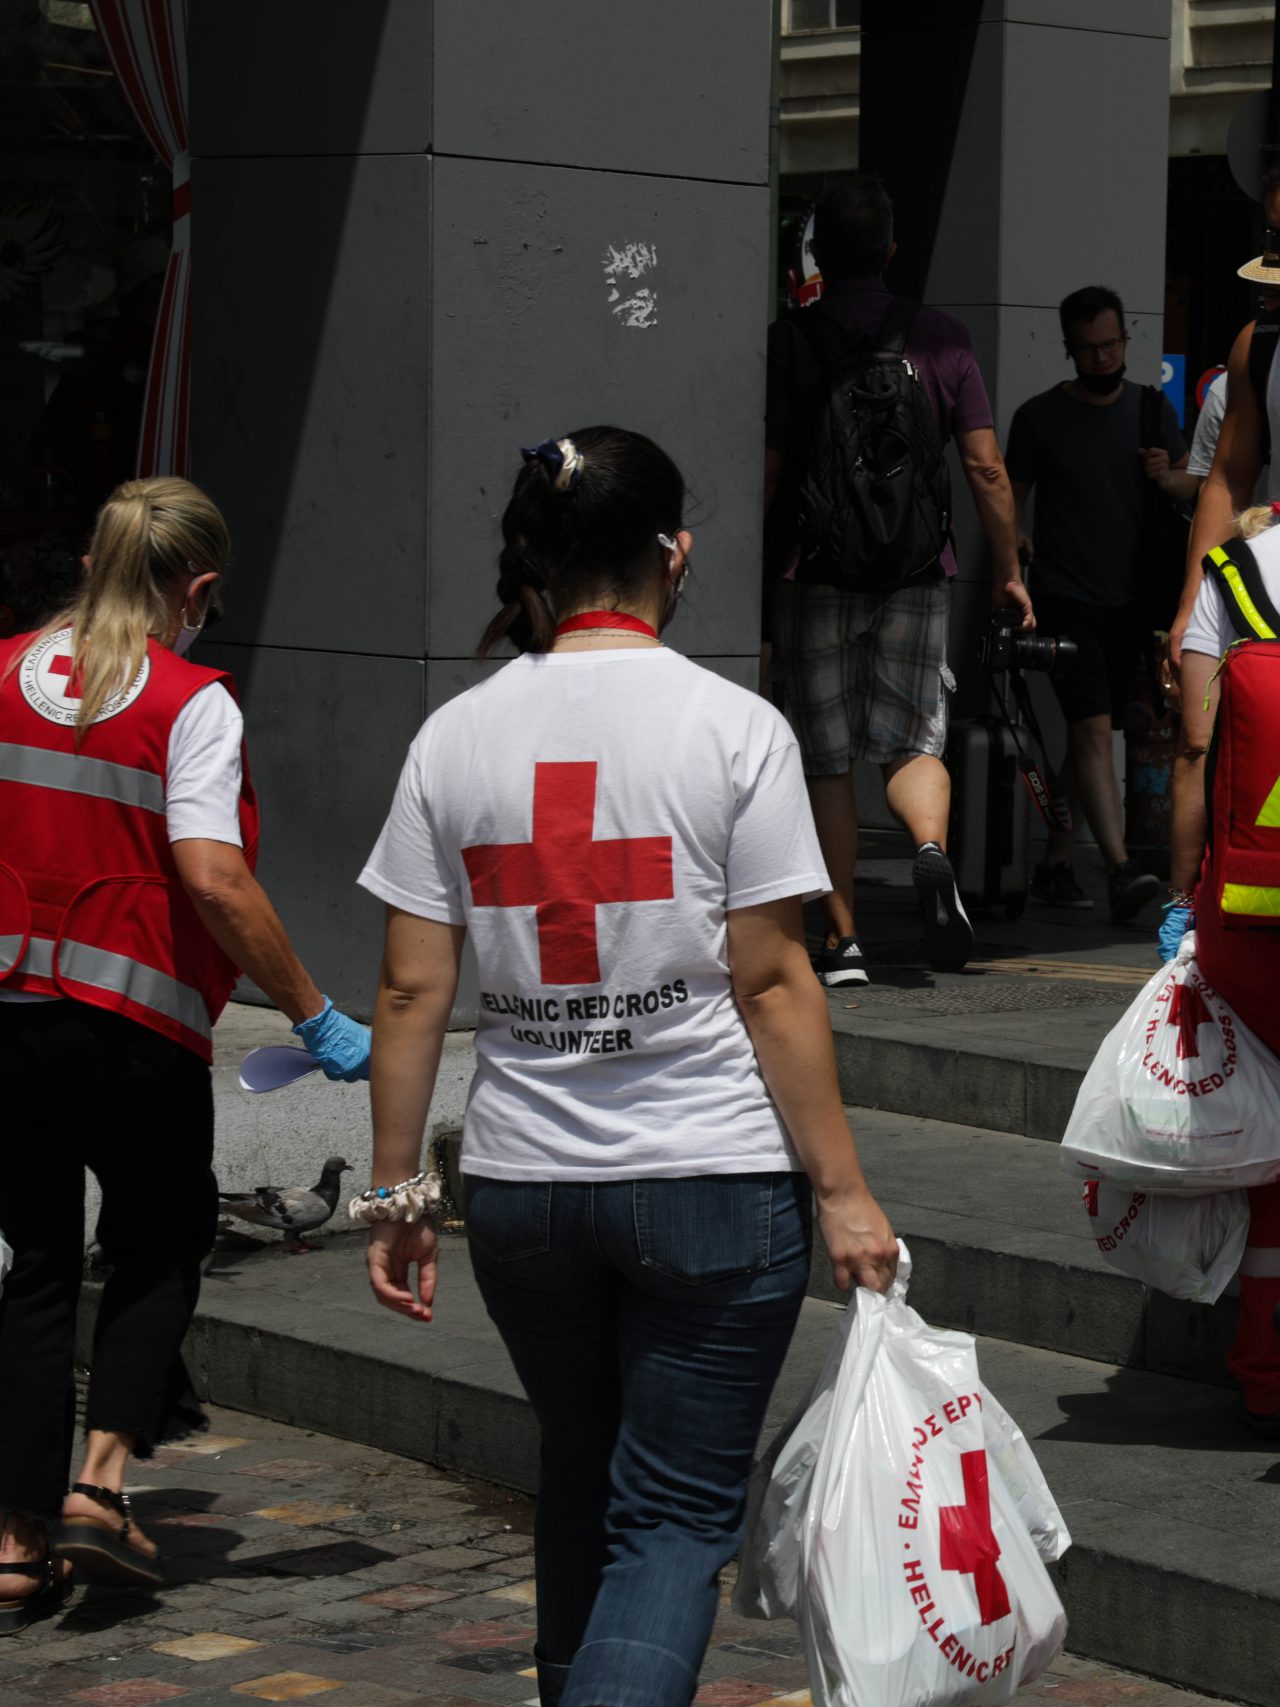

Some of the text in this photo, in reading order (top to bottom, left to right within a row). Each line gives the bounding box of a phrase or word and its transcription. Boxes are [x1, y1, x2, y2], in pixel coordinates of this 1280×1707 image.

[24, 680, 62, 720] HELLENIC
[1027, 770, 1044, 794] EOS
[566, 995, 611, 1020] RED
[613, 978, 689, 1019] CROSS
[511, 1025, 634, 1054] VOLUNTEER
[1186, 1072, 1225, 1097] RED
[903, 1560, 989, 1683] HELLENIC
